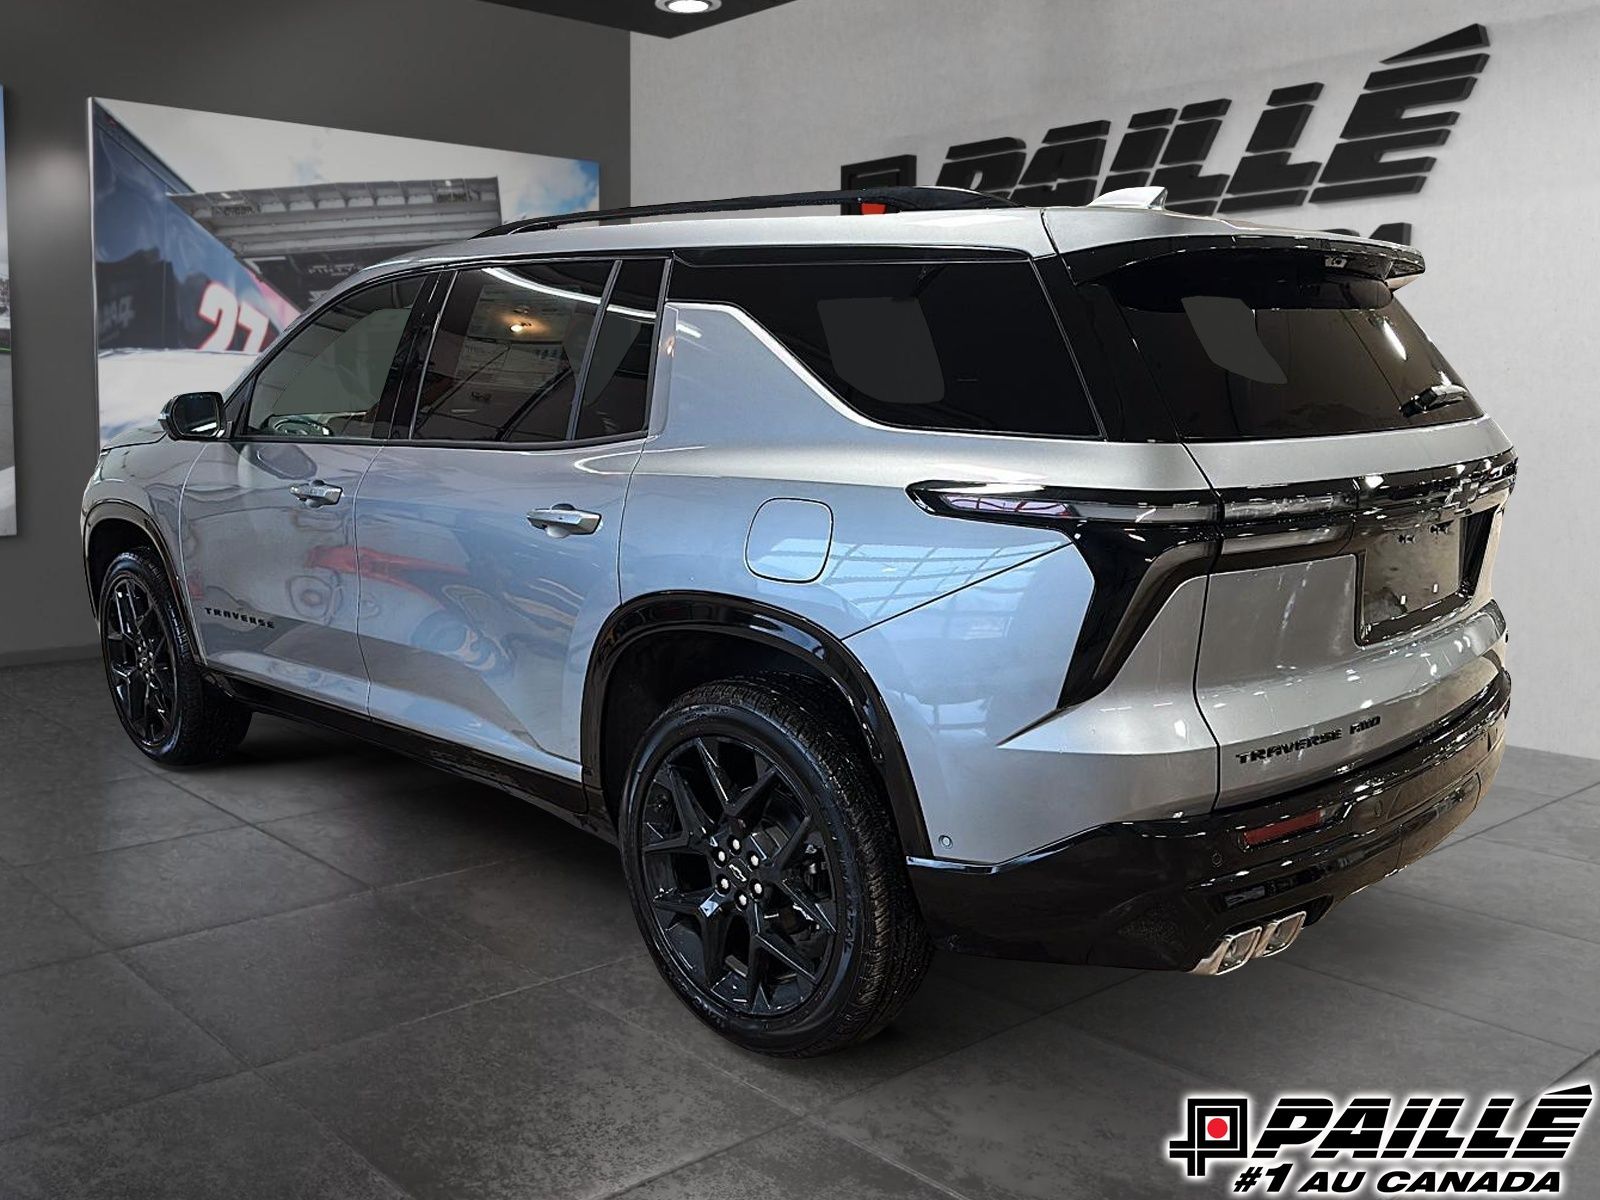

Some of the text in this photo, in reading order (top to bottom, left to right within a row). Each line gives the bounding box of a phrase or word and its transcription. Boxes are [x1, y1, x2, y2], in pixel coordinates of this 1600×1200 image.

[934, 23, 1490, 213] PAILLÉ
[198, 280, 270, 352] 27
[204, 607, 275, 629] TRAVERSE
[1235, 728, 1343, 765] TRAVERSE
